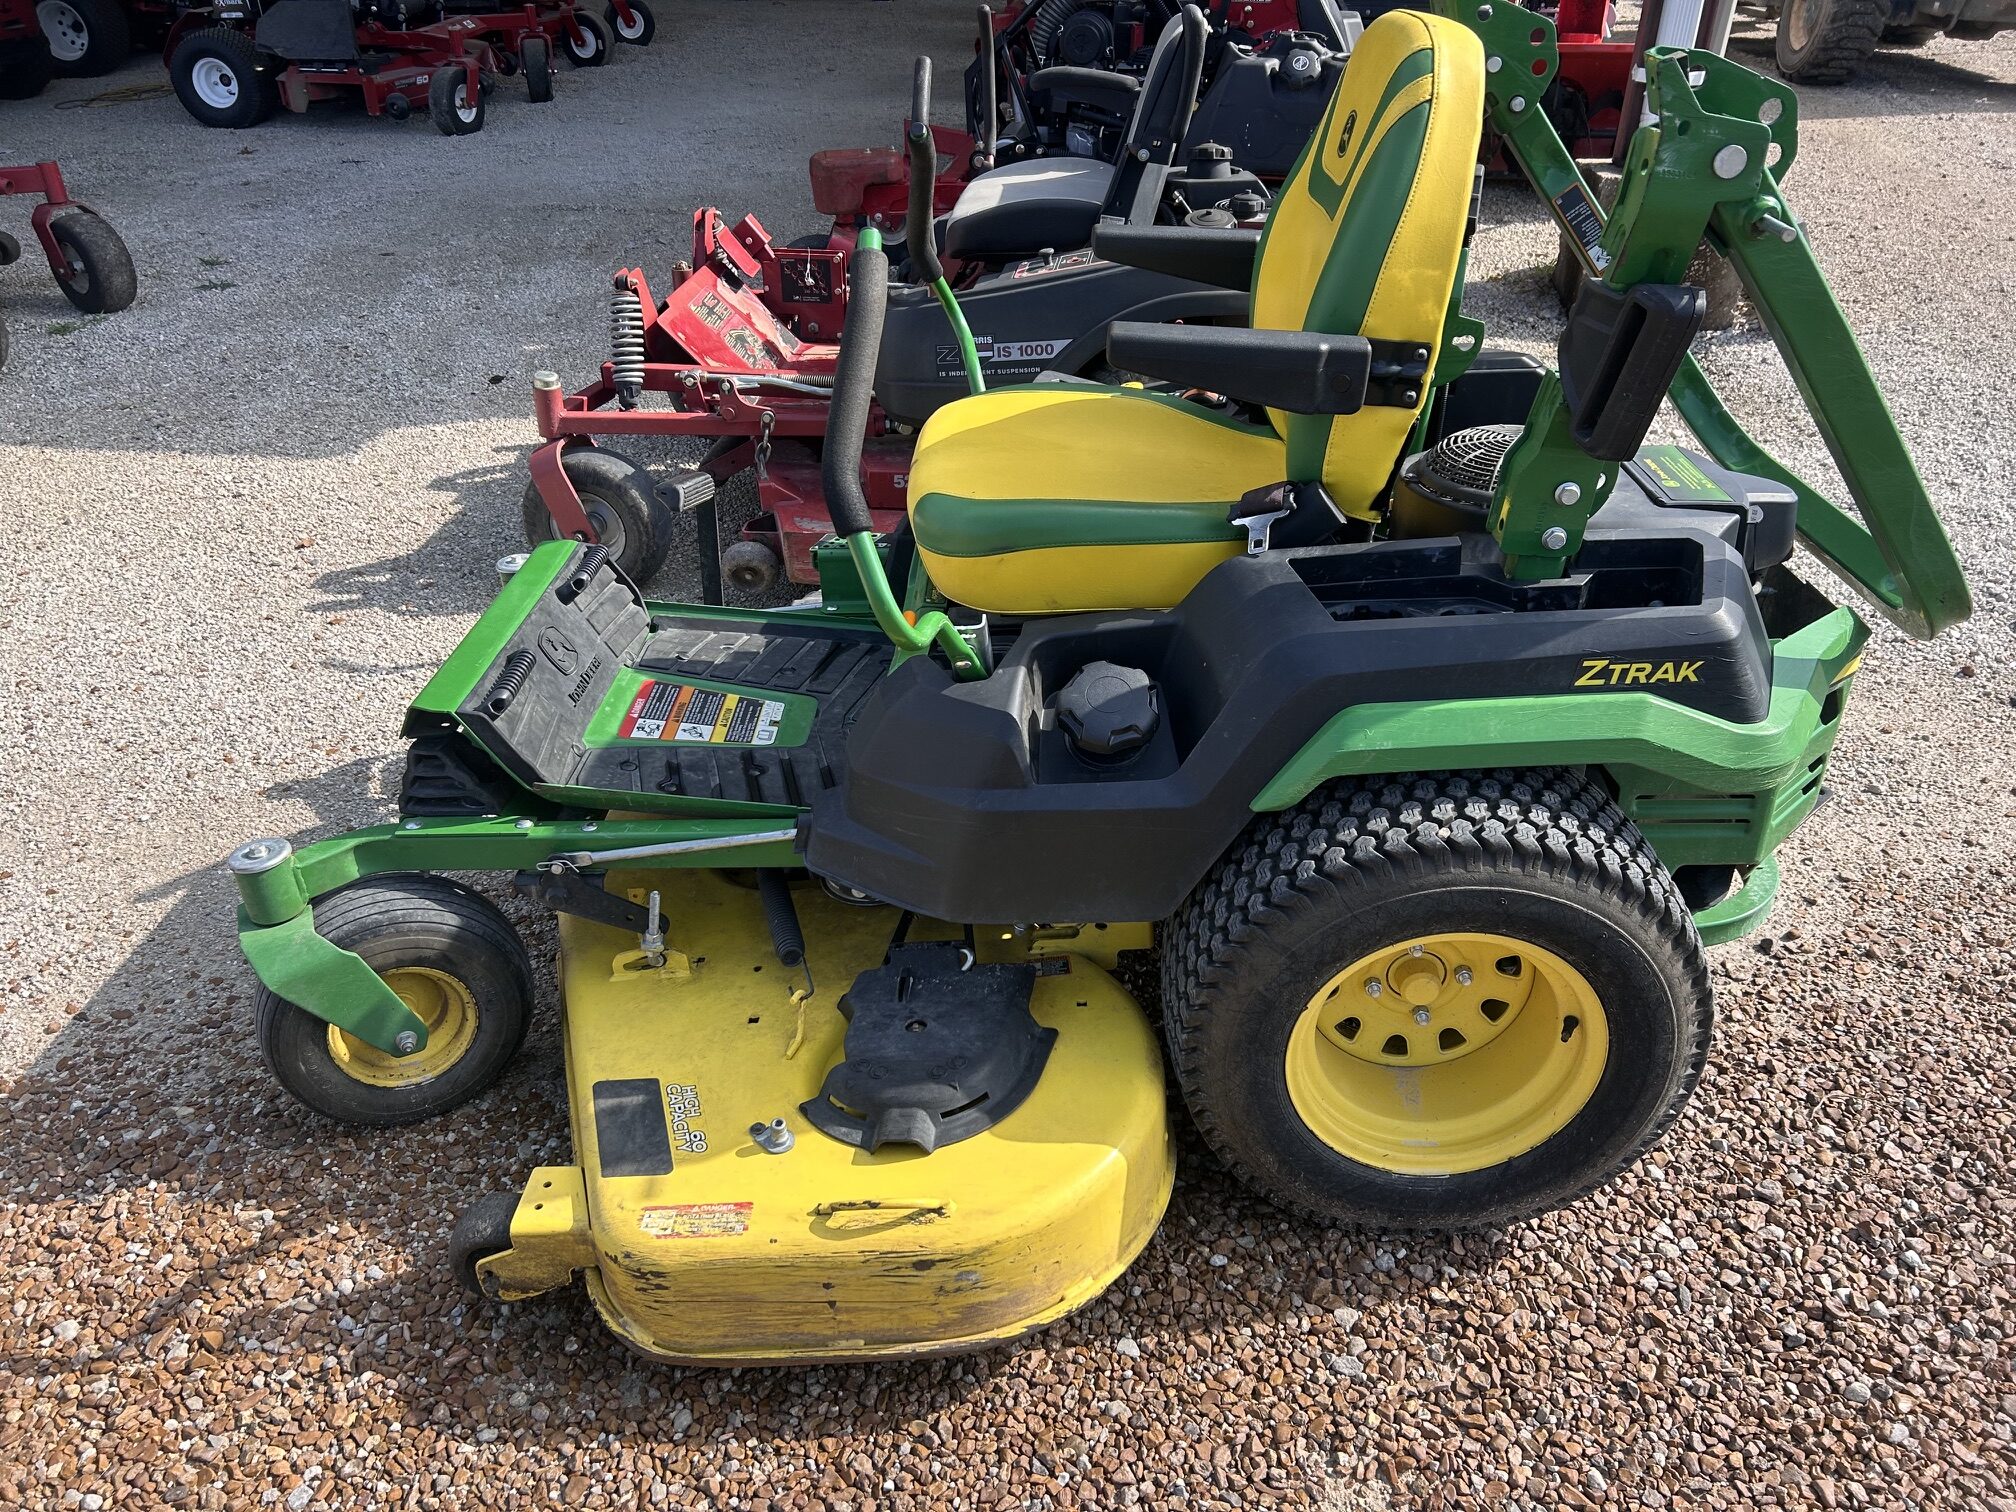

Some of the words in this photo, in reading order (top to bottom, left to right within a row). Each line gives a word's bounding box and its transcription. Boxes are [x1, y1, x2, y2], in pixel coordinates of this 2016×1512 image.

[973, 336, 993, 345] RRIS
[1017, 343, 1055, 357] 1000
[997, 366, 1041, 375] SUSPENSION
[1573, 659, 1706, 686] ZTRAK
[680, 1084, 702, 1117] HIGH
[665, 1083, 694, 1153] CAPACITY
[689, 1129, 708, 1153] 60
